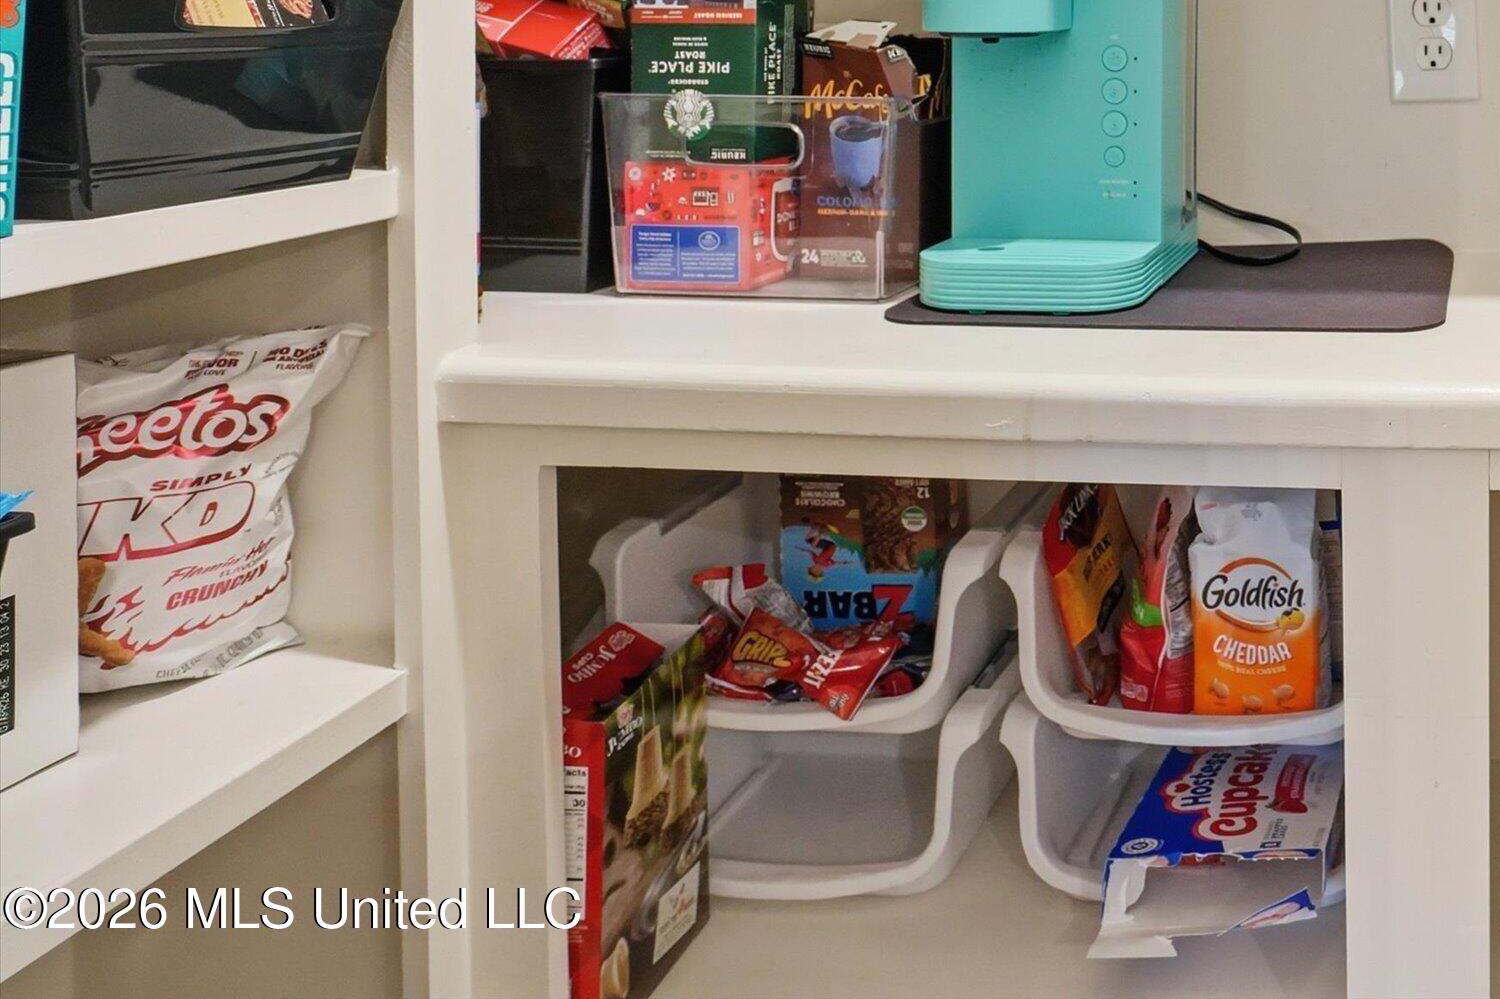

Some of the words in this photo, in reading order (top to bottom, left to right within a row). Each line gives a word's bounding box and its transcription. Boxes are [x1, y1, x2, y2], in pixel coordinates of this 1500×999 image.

[768, 23, 778, 62] PLACE
[674, 51, 706, 59] ROAST
[649, 61, 695, 74] PLACE
[699, 61, 731, 74] PIKE
[801, 249, 820, 264] 24
[150, 463, 252, 491] SIMPLY
[917, 486, 931, 498] 12
[165, 560, 269, 611] CRUNCHY
[1202, 574, 1304, 610] Goldfish
[1213, 633, 1291, 666] CHEDDAR
[571, 653, 594, 670] CUPS
[564, 768, 588, 778] acts
[1180, 751, 1232, 807] Hostess
[1209, 744, 1277, 837] Cupcak
[573, 798, 586, 807] 30
